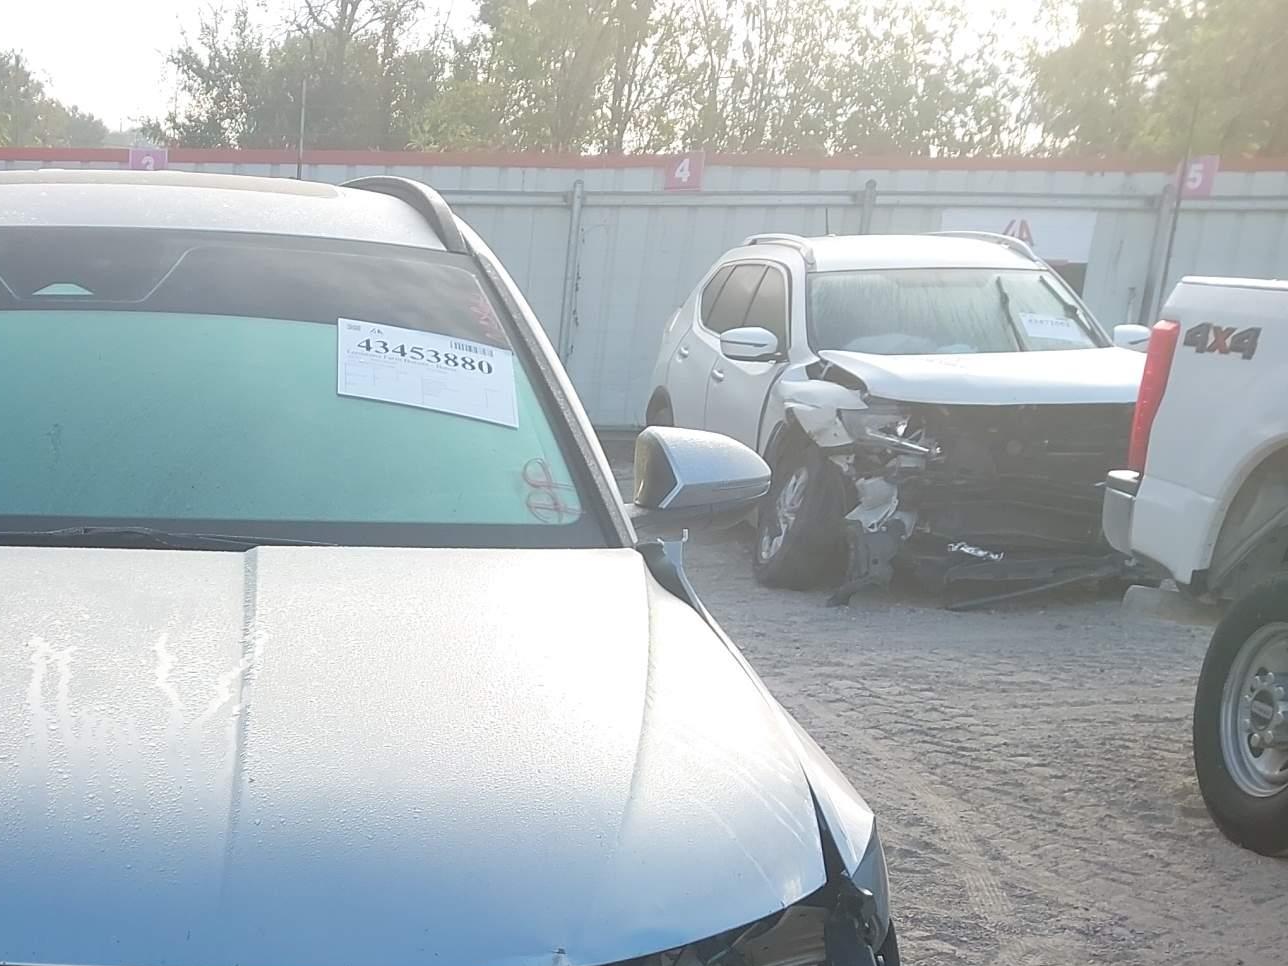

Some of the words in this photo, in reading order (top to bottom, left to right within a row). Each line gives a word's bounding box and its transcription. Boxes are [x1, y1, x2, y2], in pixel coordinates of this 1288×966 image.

[674, 158, 691, 182] 4
[1185, 163, 1204, 190] 5
[356, 337, 494, 375] 43453880
